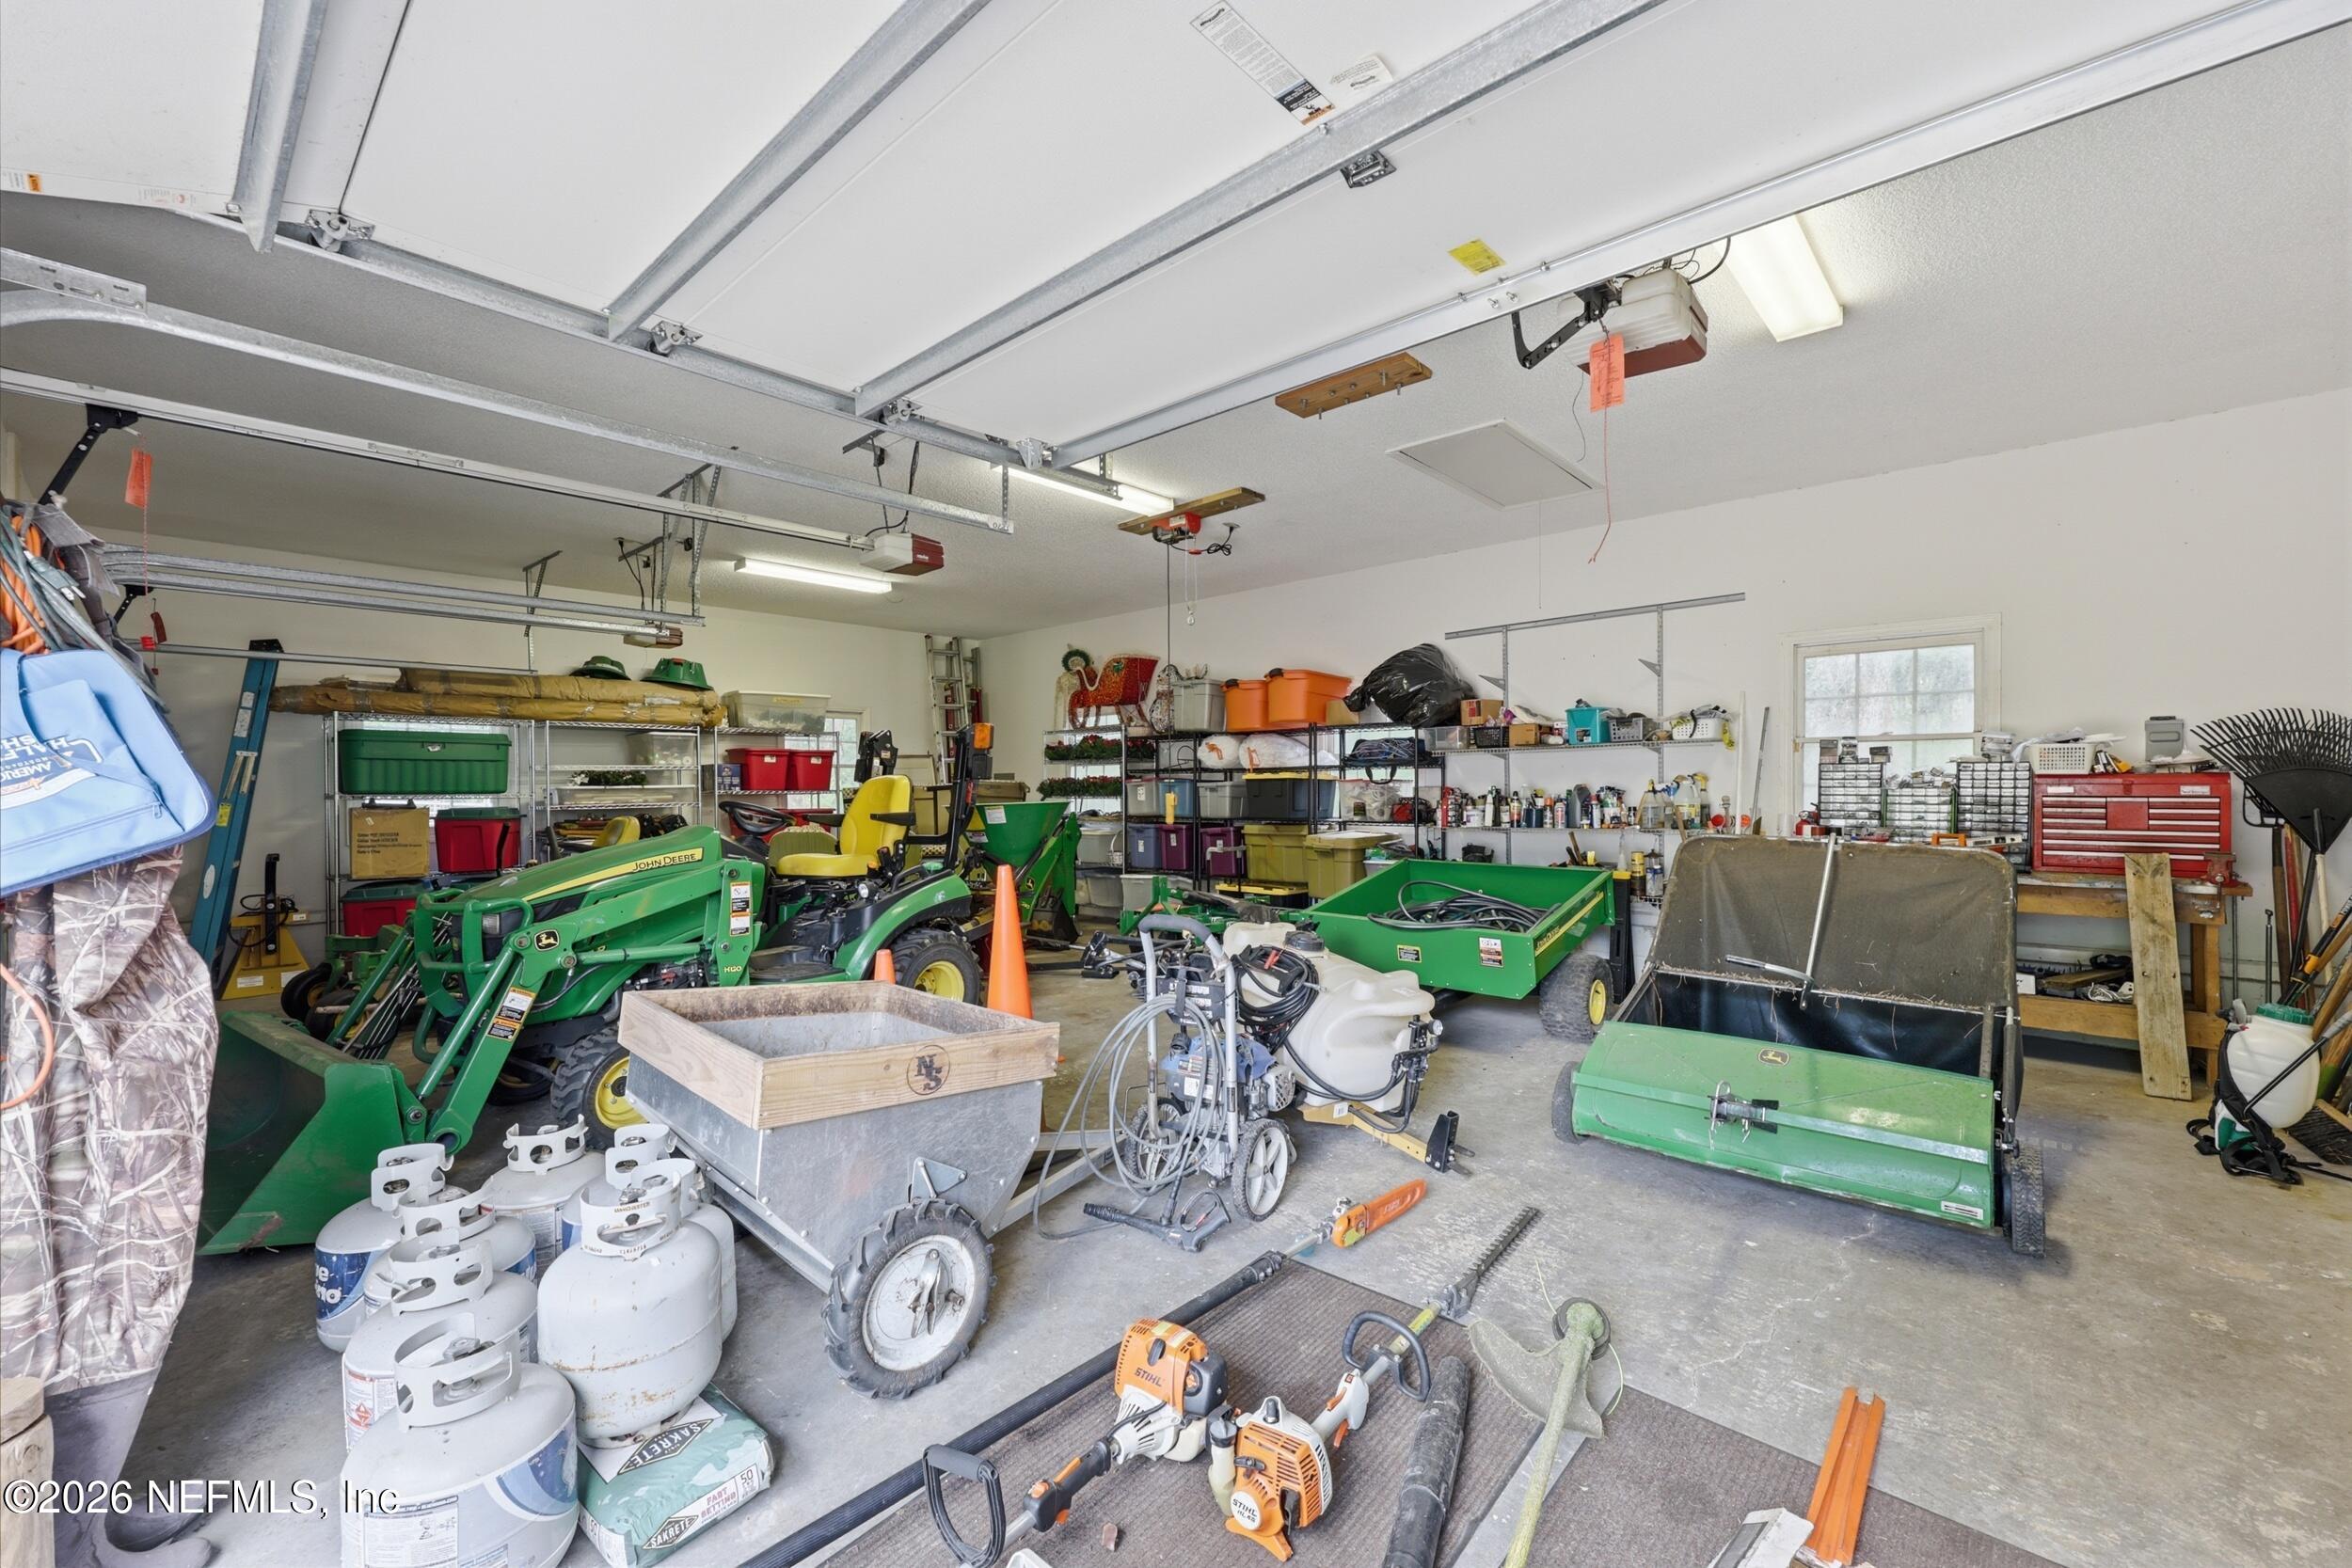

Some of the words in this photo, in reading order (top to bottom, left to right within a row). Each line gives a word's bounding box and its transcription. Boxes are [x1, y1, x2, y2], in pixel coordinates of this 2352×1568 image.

[632, 859, 662, 871] JOHN
[663, 853, 696, 866] DEERE
[1135, 1368, 1163, 1387] STIHL
[630, 1422, 702, 1468] SAKRETE
[740, 1469, 754, 1484] 50
[1232, 1498, 1258, 1517] STIHL
[650, 1519, 693, 1547] SAKRETE
